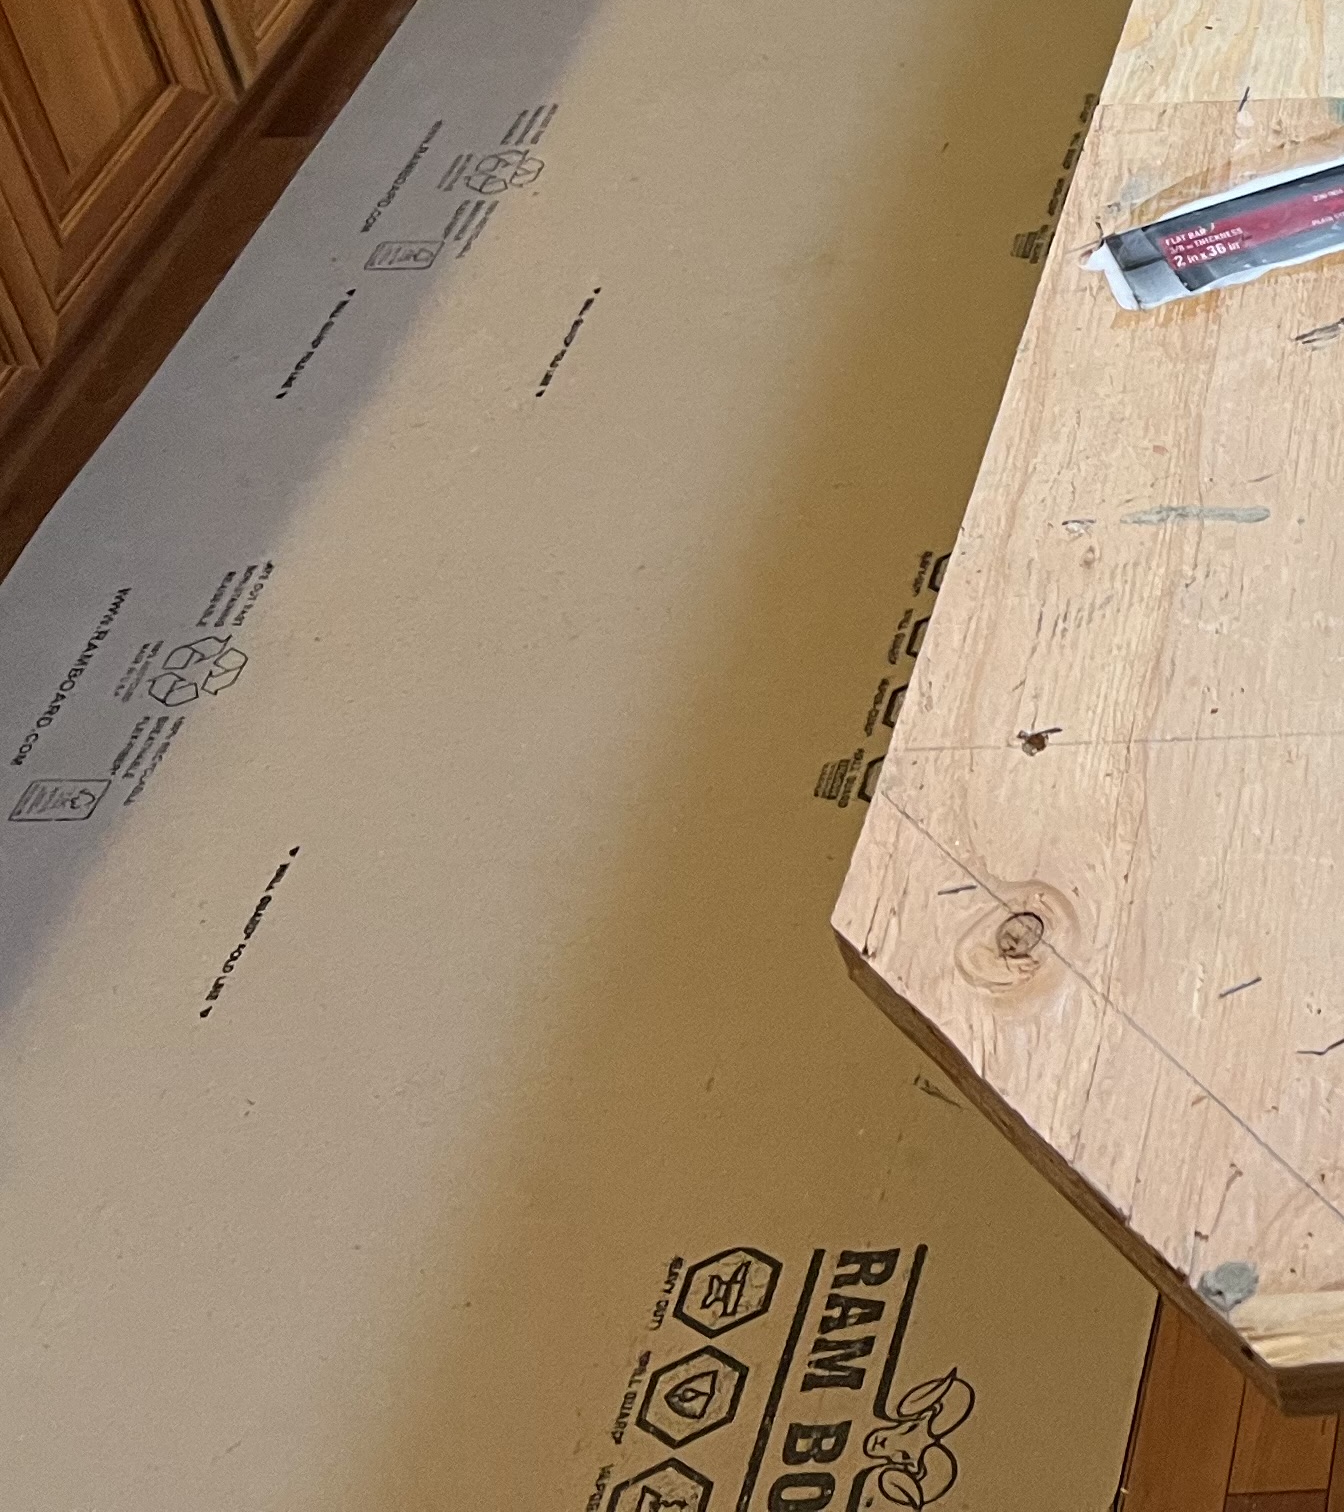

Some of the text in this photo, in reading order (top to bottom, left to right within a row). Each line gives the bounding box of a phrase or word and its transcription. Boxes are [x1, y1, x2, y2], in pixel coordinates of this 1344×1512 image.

[1165, 234, 1186, 246] FLAT
[1173, 255, 1186, 268] 2
[1207, 243, 1226, 257] 36
[10, 587, 131, 767] WWW.RAMBOARD.COM
[801, 1247, 901, 1392] RAM
